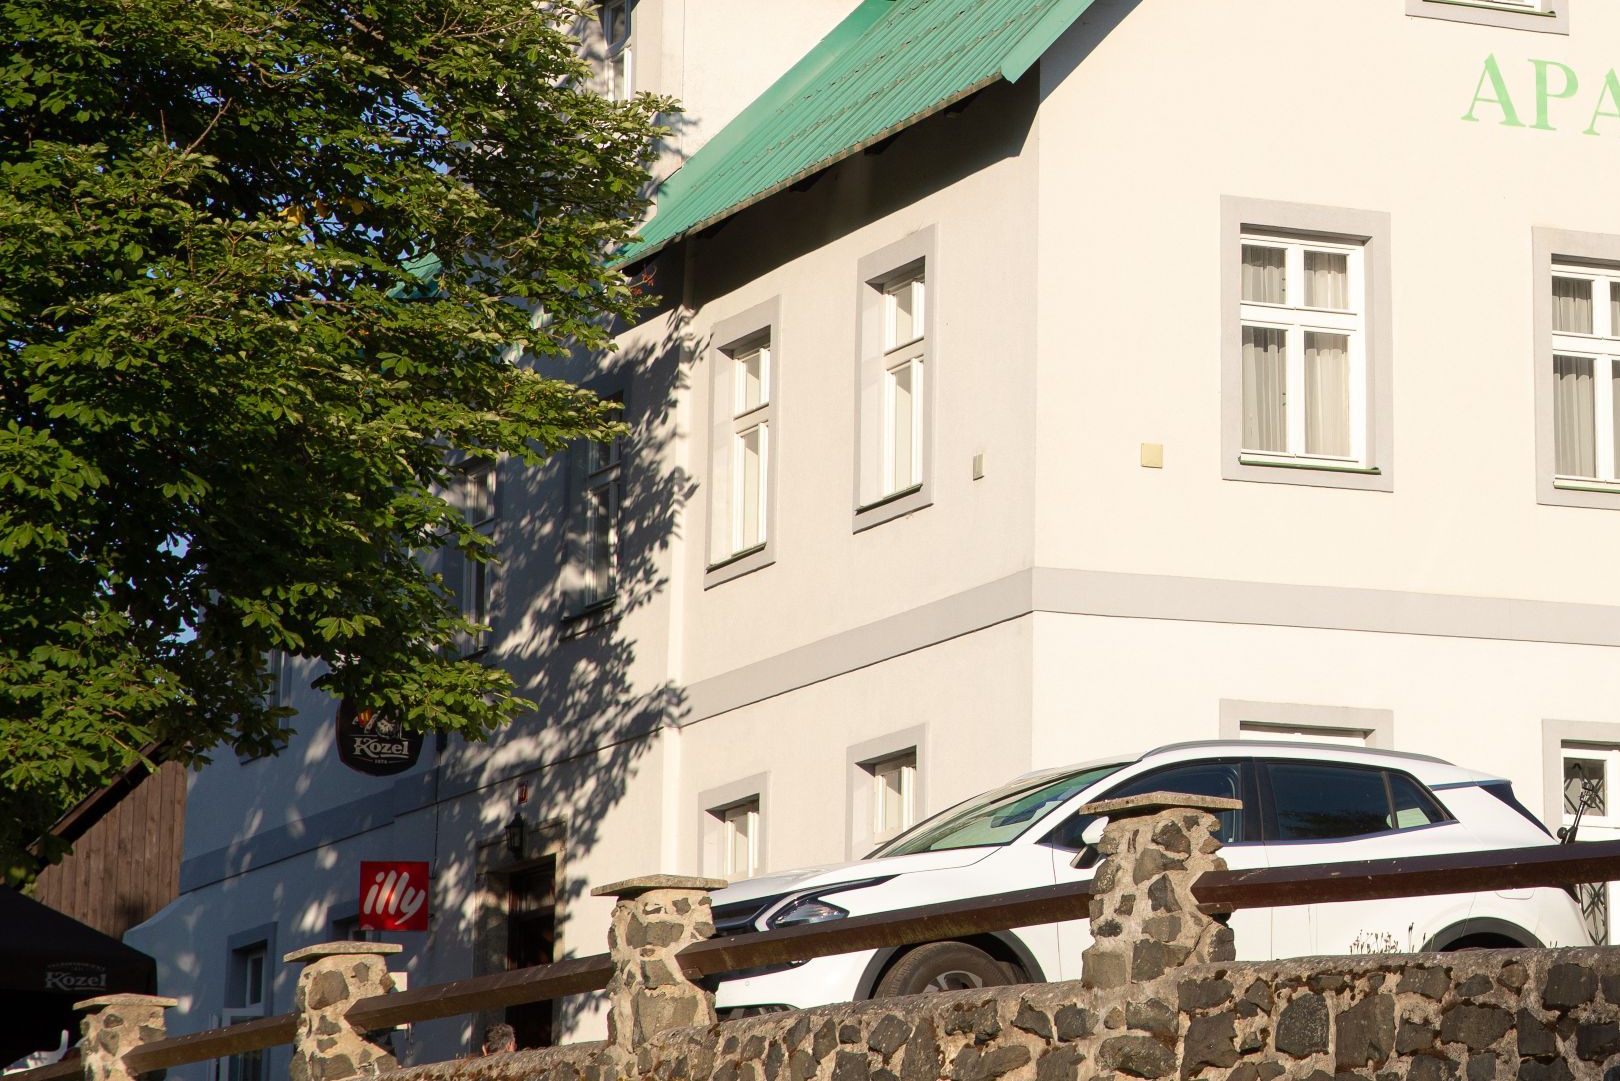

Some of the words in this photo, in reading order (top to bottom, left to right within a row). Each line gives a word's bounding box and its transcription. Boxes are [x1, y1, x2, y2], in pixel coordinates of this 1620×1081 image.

[352, 737, 410, 759] Kozel
[363, 870, 426, 926] illy
[45, 971, 108, 991] Kozel
